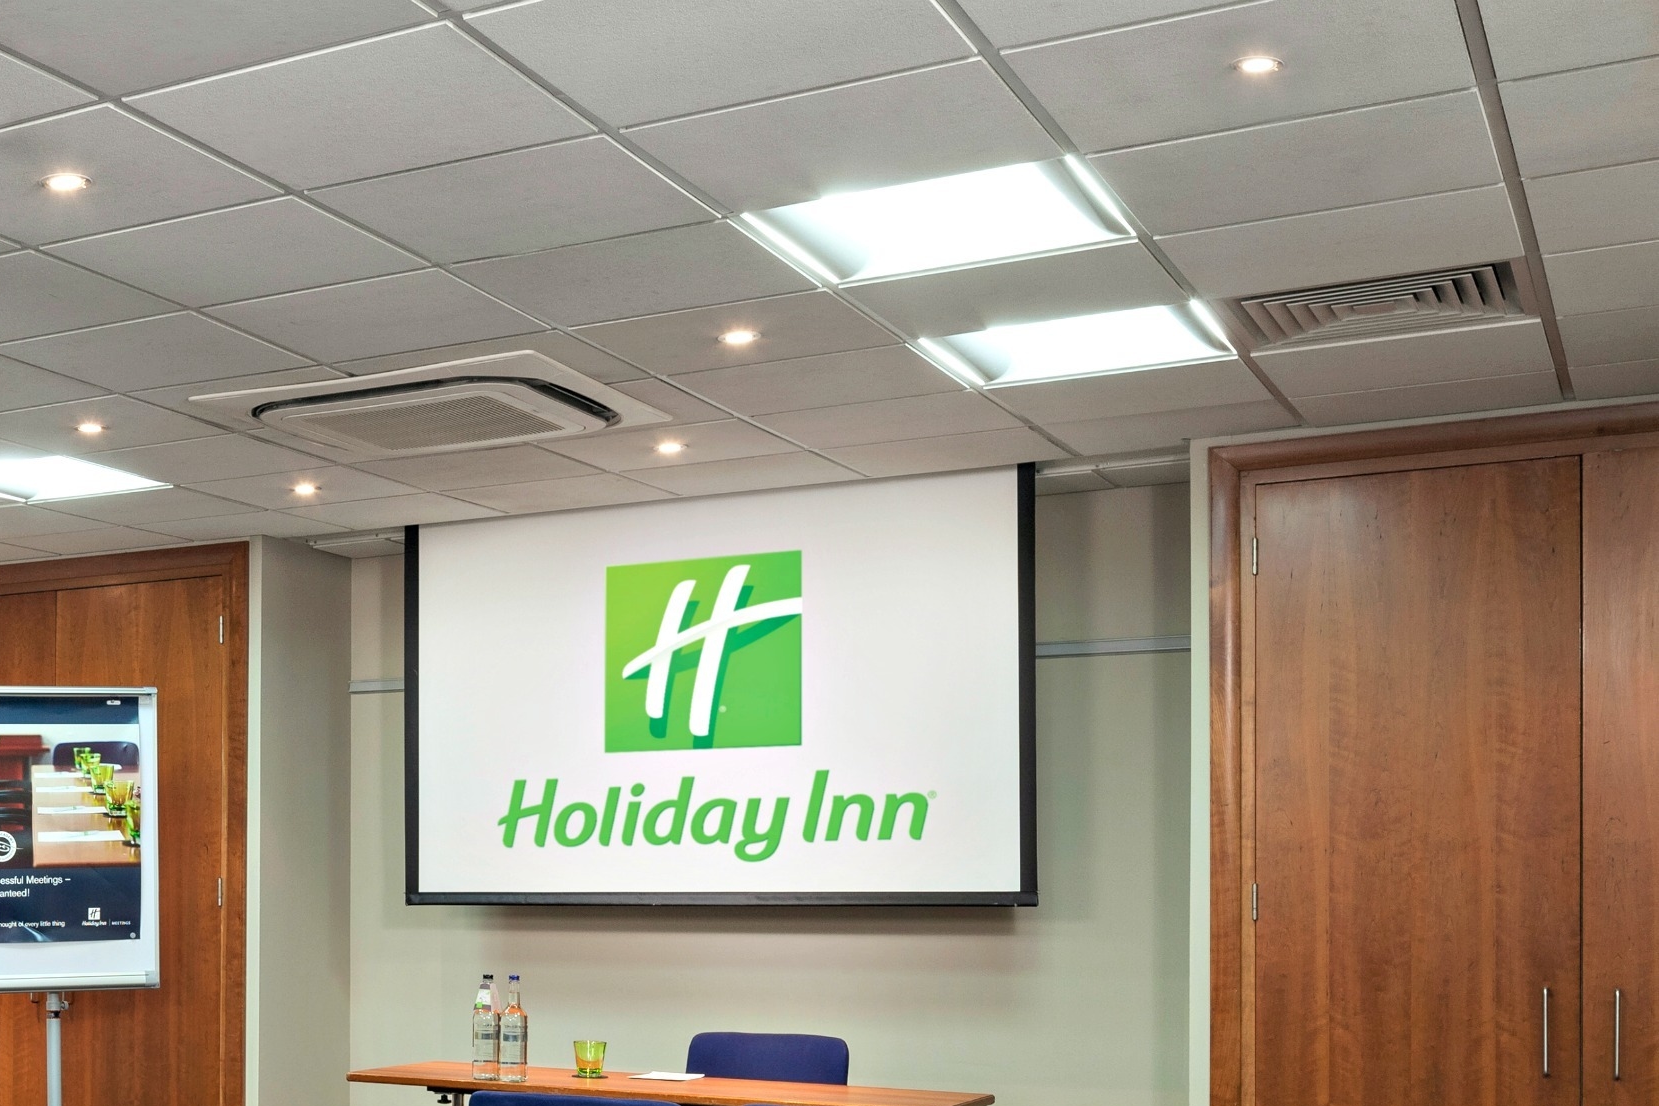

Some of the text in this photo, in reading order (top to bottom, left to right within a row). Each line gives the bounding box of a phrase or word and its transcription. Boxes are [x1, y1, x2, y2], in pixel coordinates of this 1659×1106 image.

[497, 769, 929, 863] Holiday Inn
[25, 874, 63, 886] Meetings
[24, 921, 39, 929] every
[51, 920, 66, 928] thing
